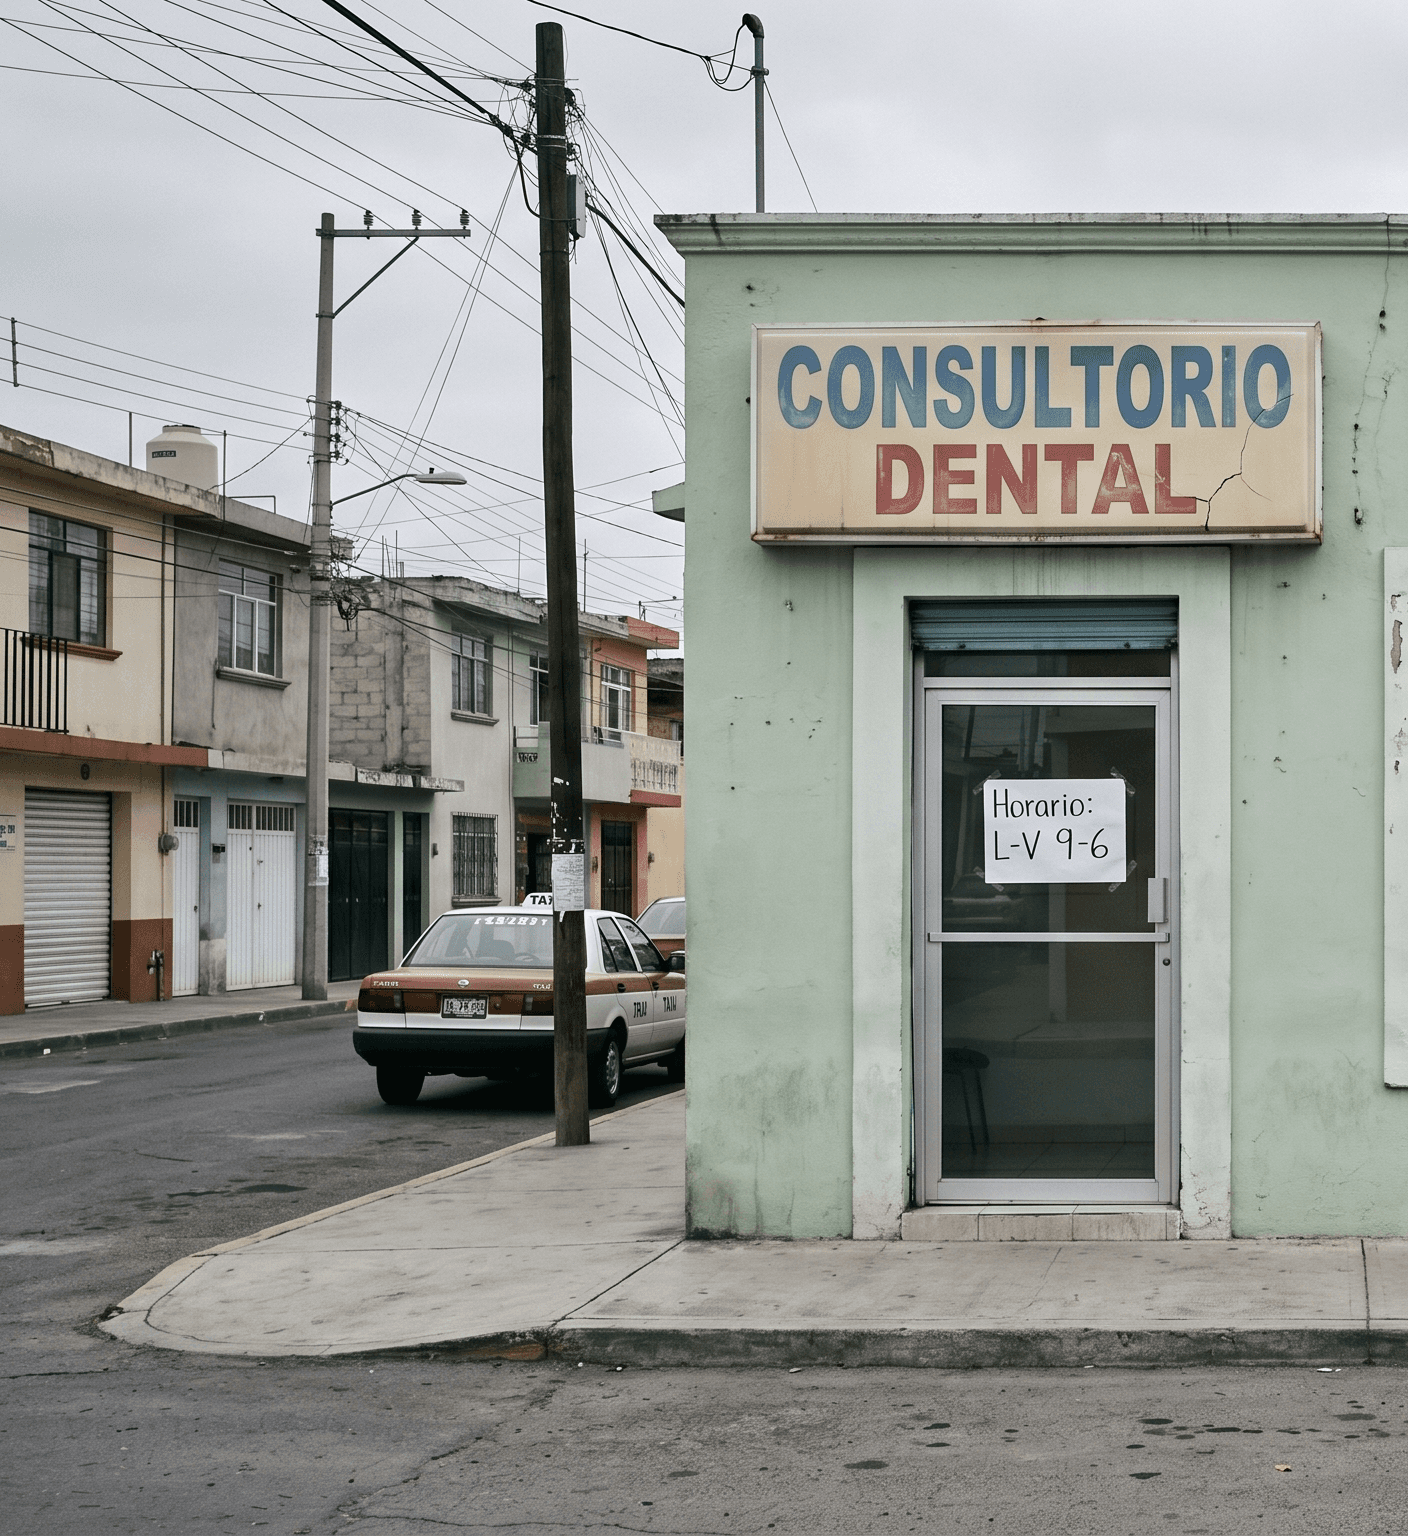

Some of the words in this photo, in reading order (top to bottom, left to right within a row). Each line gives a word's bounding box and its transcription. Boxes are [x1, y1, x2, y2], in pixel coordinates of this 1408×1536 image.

[777, 344, 1292, 429] CONSULTORIO
[875, 443, 1197, 515] DENTAL
[993, 788, 1093, 818] Horario:
[994, 830, 1041, 861] L-V
[1056, 828, 1109, 860] 9-6
